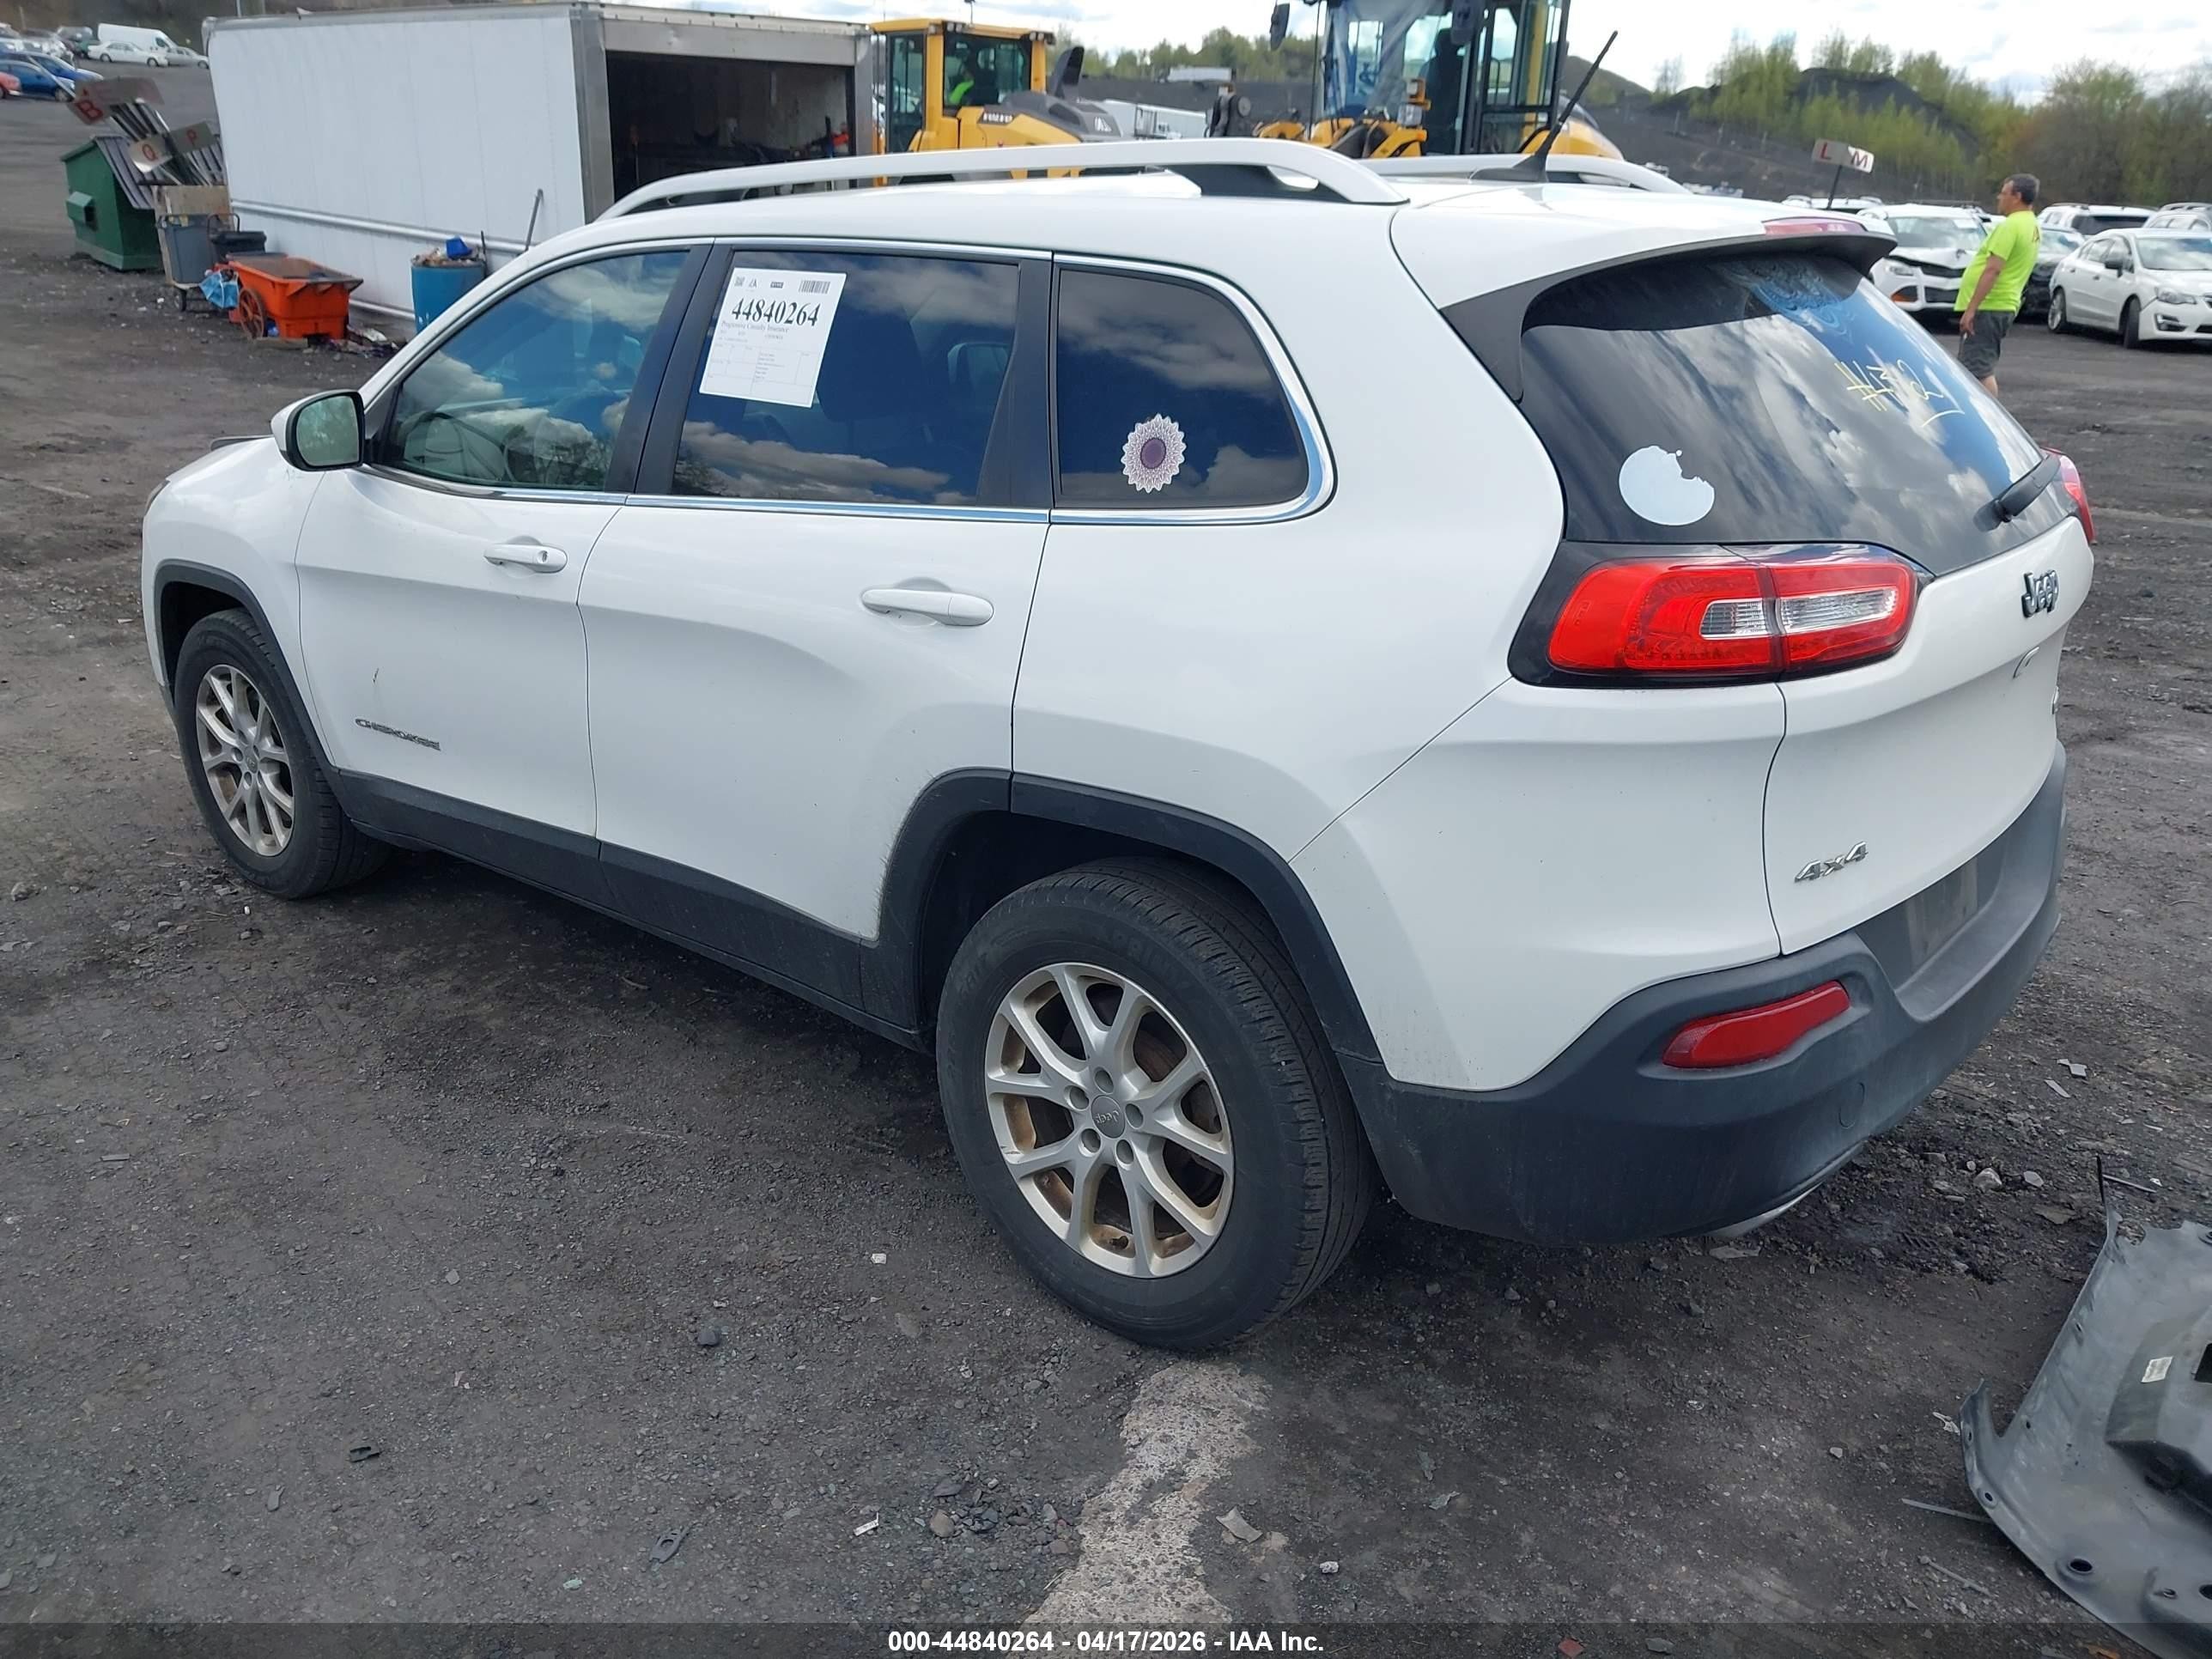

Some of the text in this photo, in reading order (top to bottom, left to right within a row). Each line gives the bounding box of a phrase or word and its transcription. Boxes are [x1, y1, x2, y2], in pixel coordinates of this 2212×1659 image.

[76, 99, 104, 123] B
[185, 129, 198, 146] P
[141, 143, 160, 162] Q
[1820, 142, 1832, 161] L
[1850, 150, 1869, 169] M
[732, 297, 821, 326] 44840264
[2021, 569, 2060, 618] Jeep
[1095, 1109, 1120, 1124] Jeep
